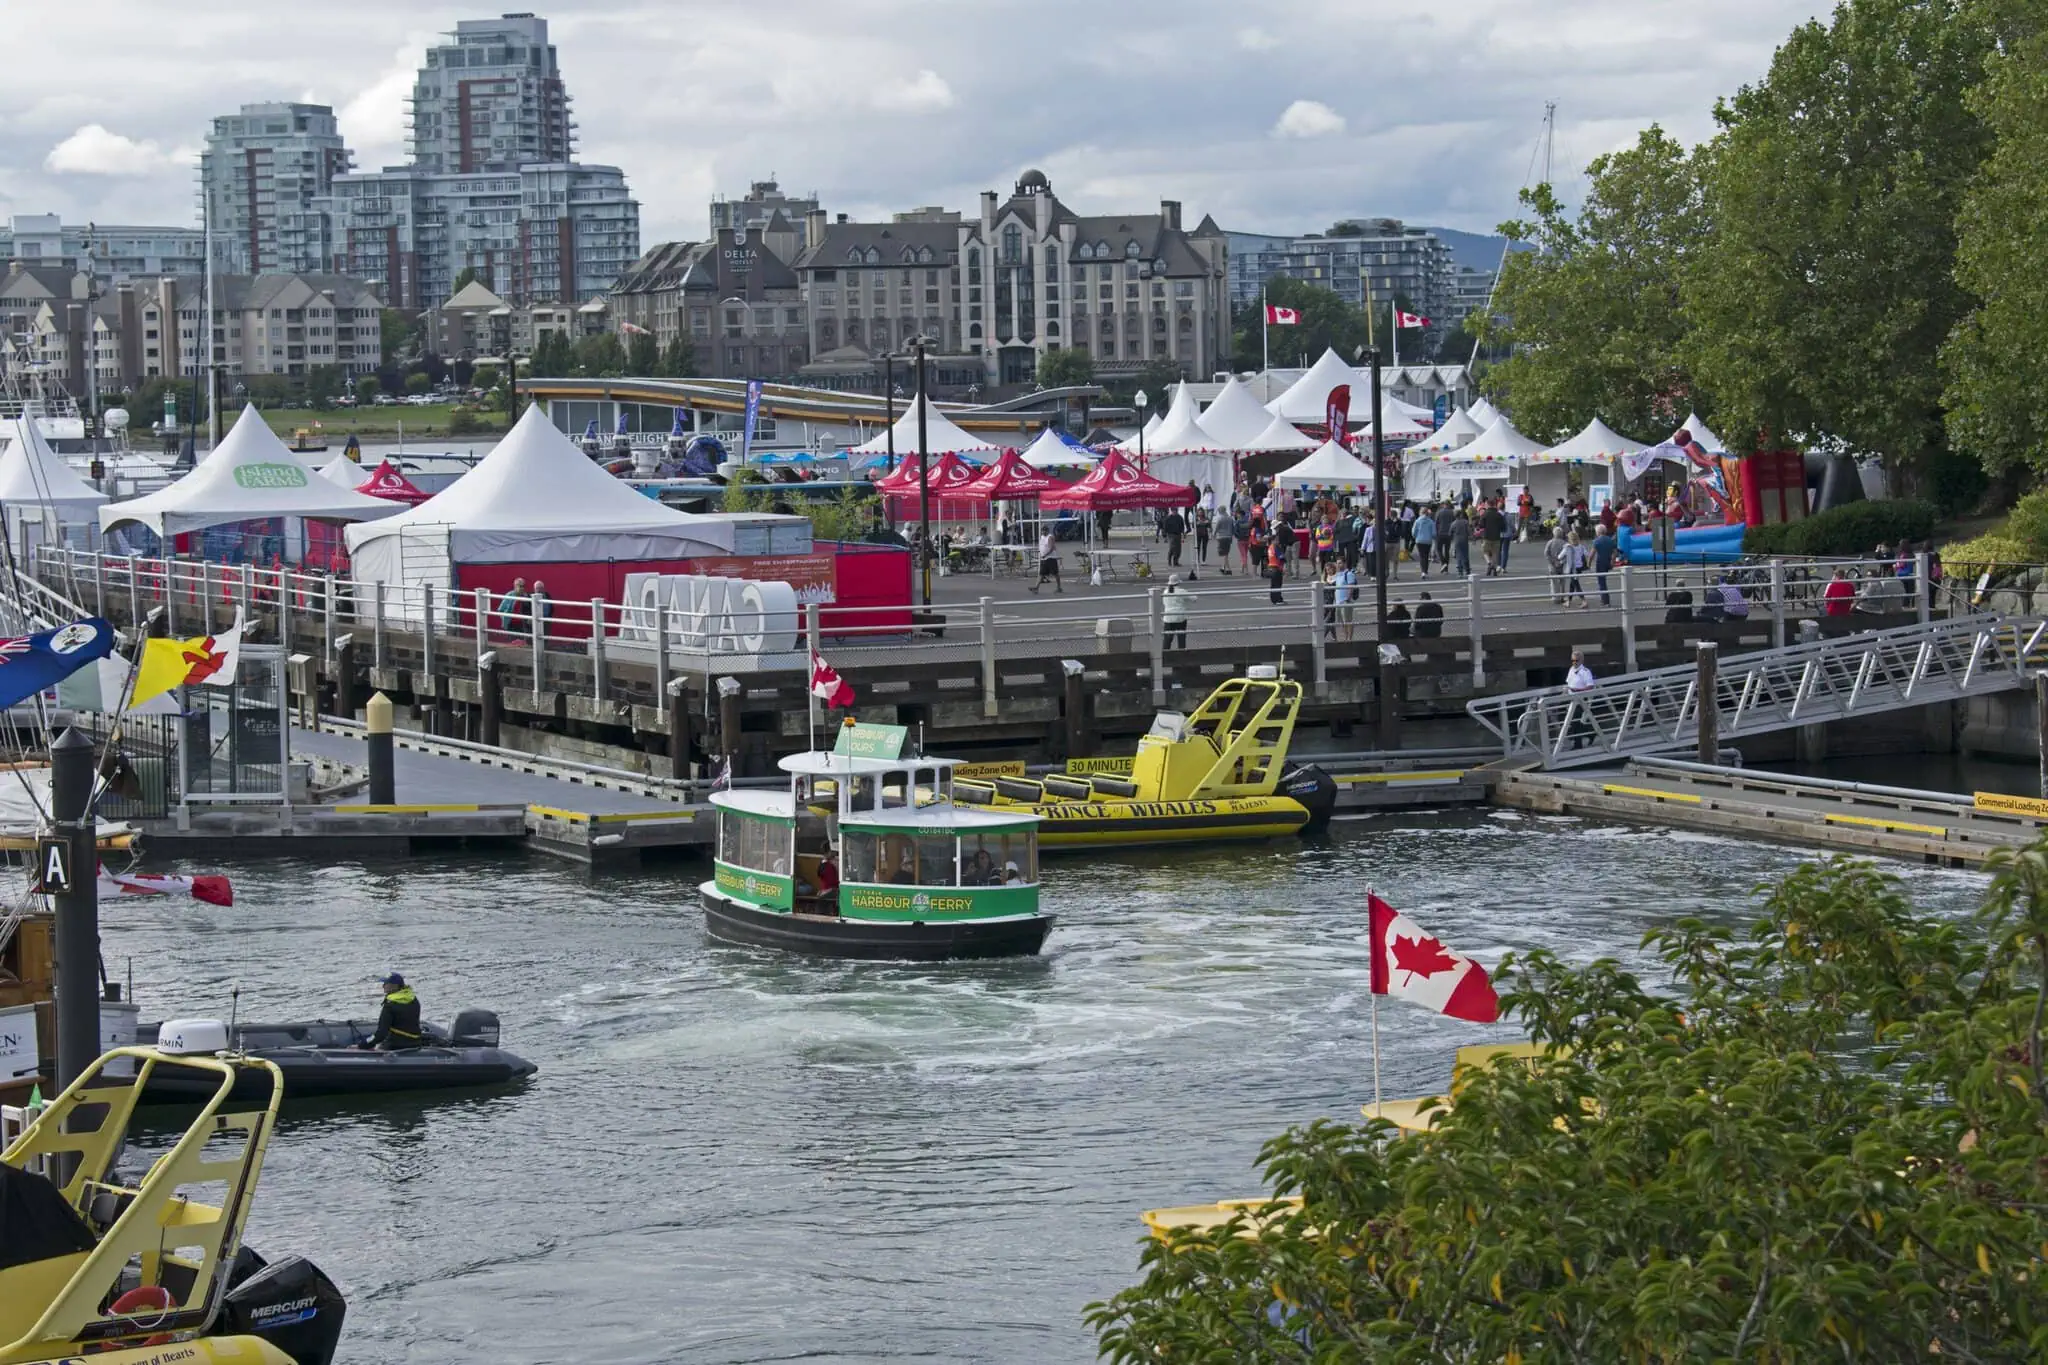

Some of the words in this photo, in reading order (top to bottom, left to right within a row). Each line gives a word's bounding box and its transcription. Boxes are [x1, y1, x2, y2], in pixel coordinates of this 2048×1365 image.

[724, 249, 757, 258] DELTA
[953, 767, 978, 778] ading
[979, 765, 1000, 775] Zone
[1001, 764, 1020, 776] Only
[1071, 760, 1084, 772] 30
[1088, 759, 1132, 771] MINUTE
[1032, 806, 1111, 819] PRINCE
[1128, 801, 1217, 817] WHALES
[1231, 800, 1268, 812] MAJESTY
[1977, 795, 2014, 809] Commercial
[2015, 801, 2040, 814] Loading
[46, 846, 66, 883] A
[756, 882, 783, 897] FERRY
[852, 895, 910, 909] HARBOUR
[930, 899, 972, 910] FERRY
[250, 1296, 317, 1319] MERCURY
[162, 1347, 195, 1363] Hearts
